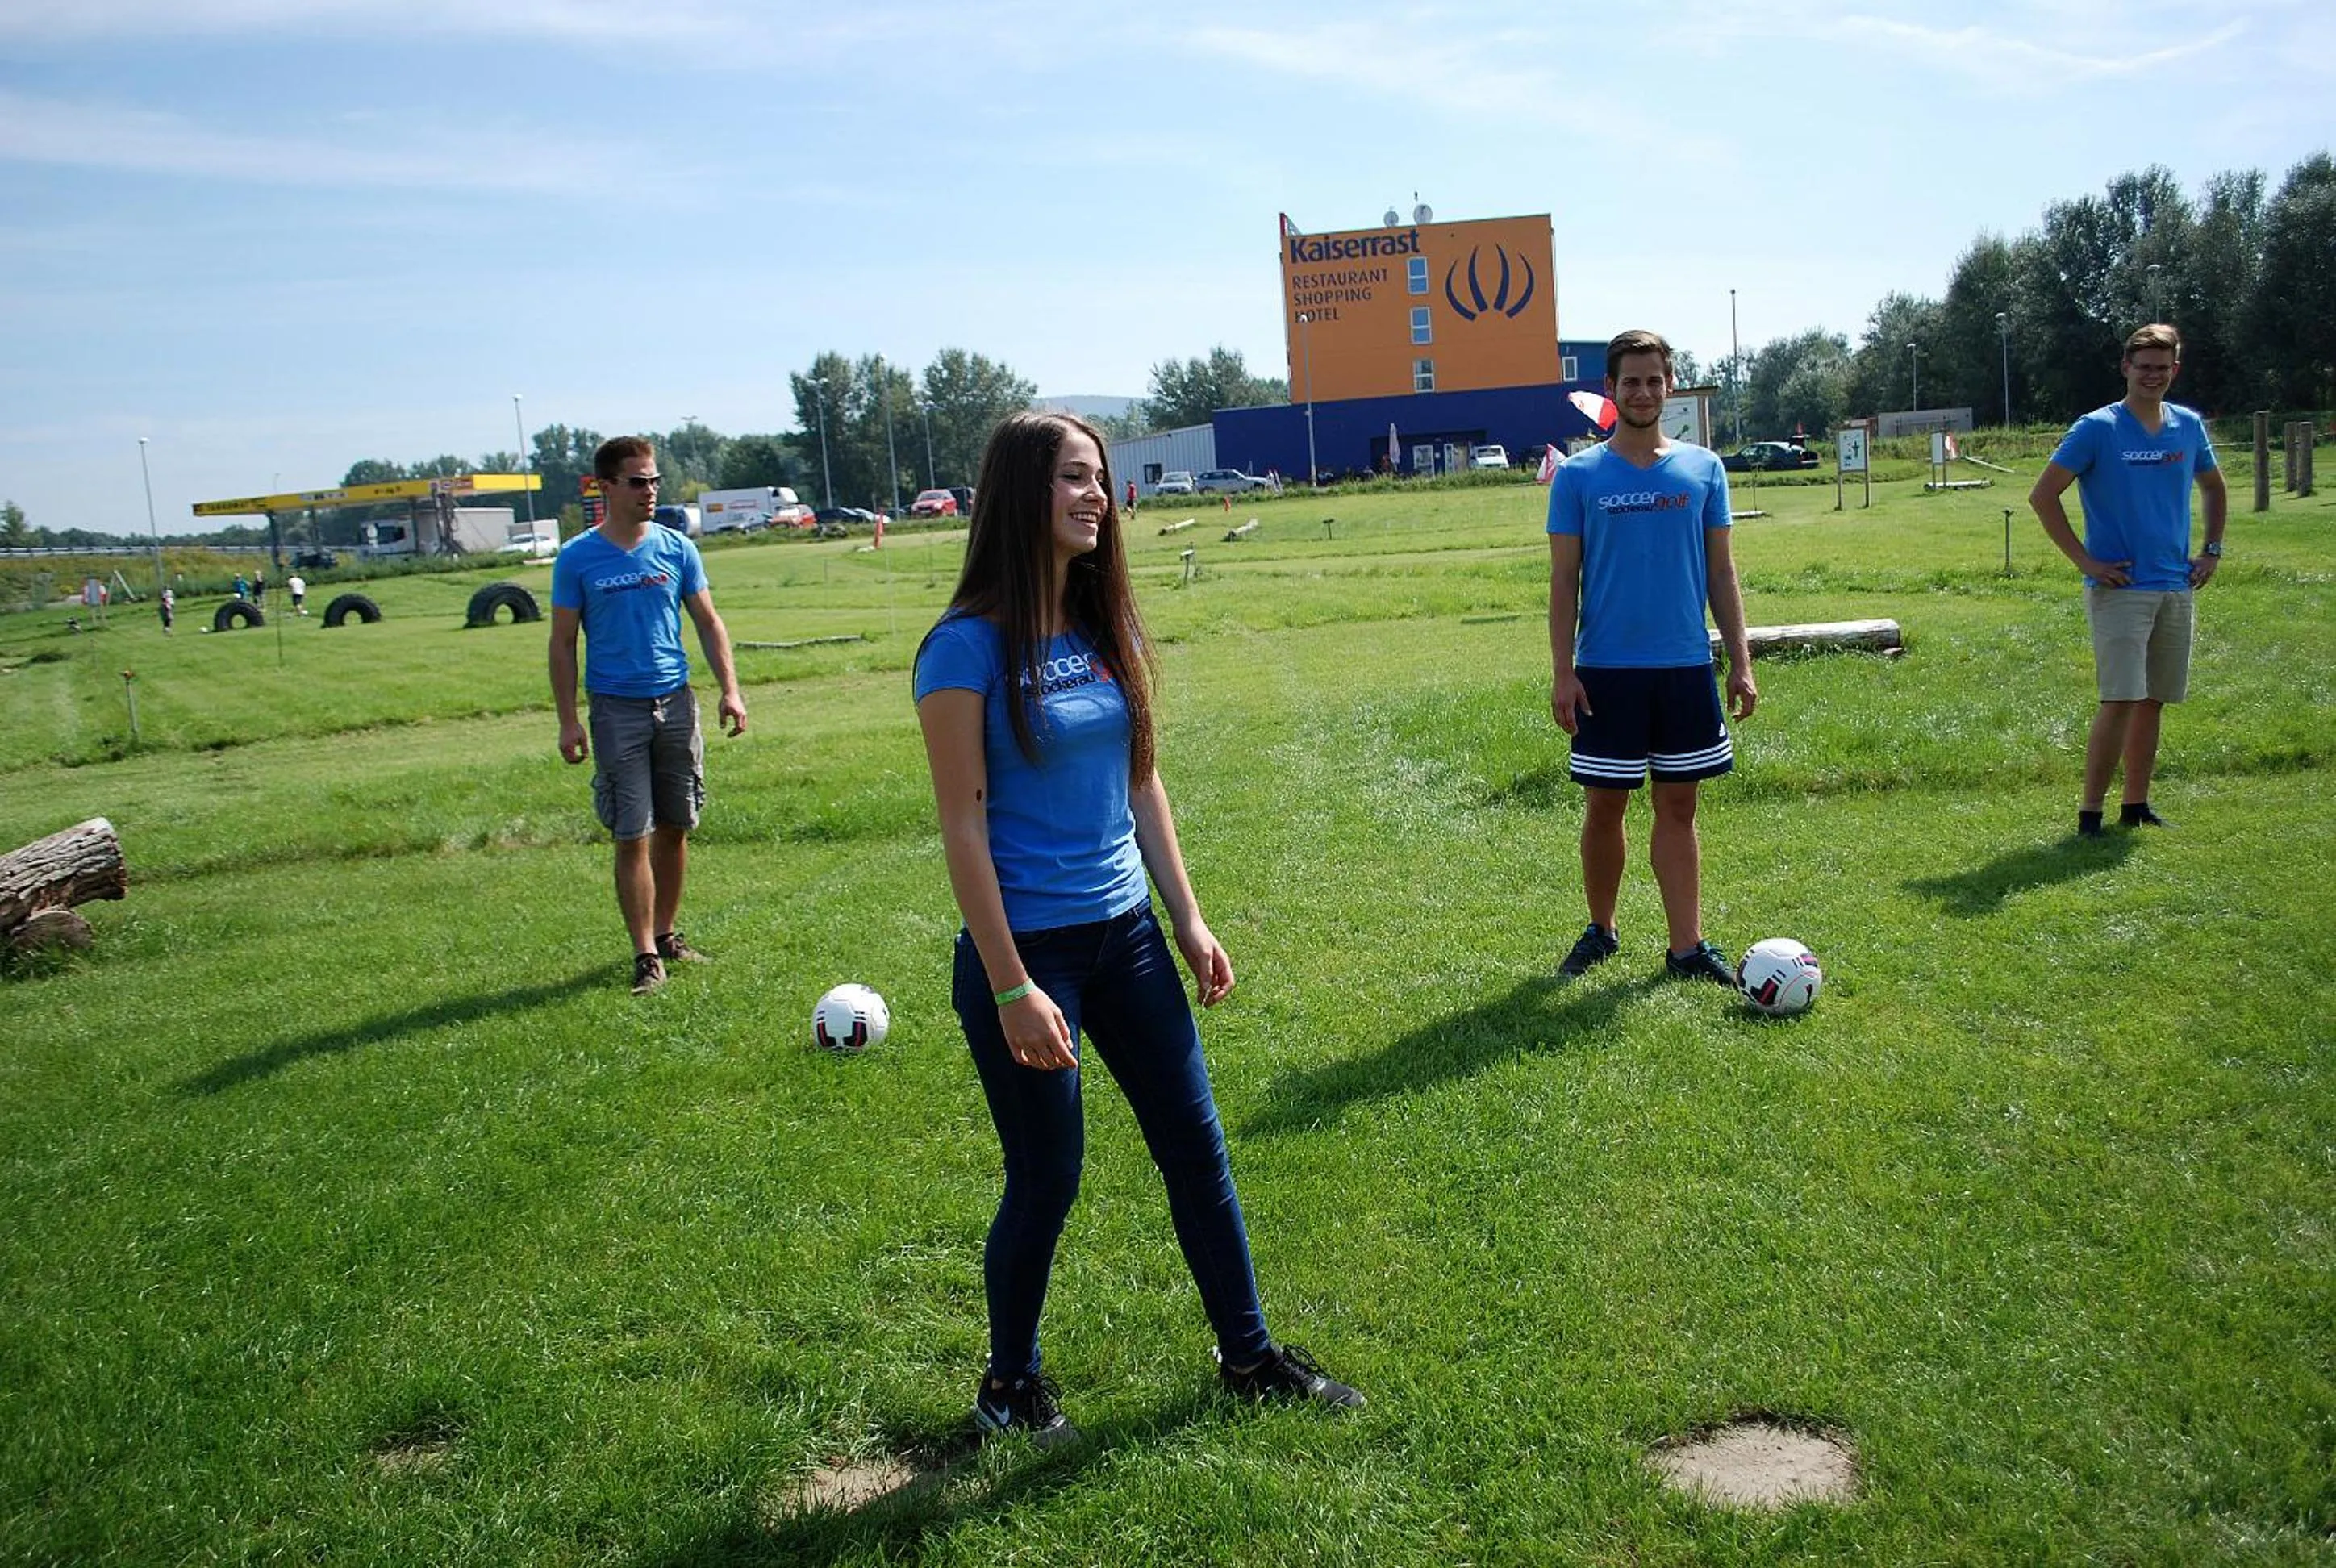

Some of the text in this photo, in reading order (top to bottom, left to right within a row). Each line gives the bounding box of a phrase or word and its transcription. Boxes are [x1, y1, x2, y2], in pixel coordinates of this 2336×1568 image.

[1291, 229, 1420, 264] Kaiserrast
[1292, 268, 1388, 290] RESTAURANT
[1294, 287, 1372, 307] SHOPPING
[1295, 307, 1340, 324] HOTEL
